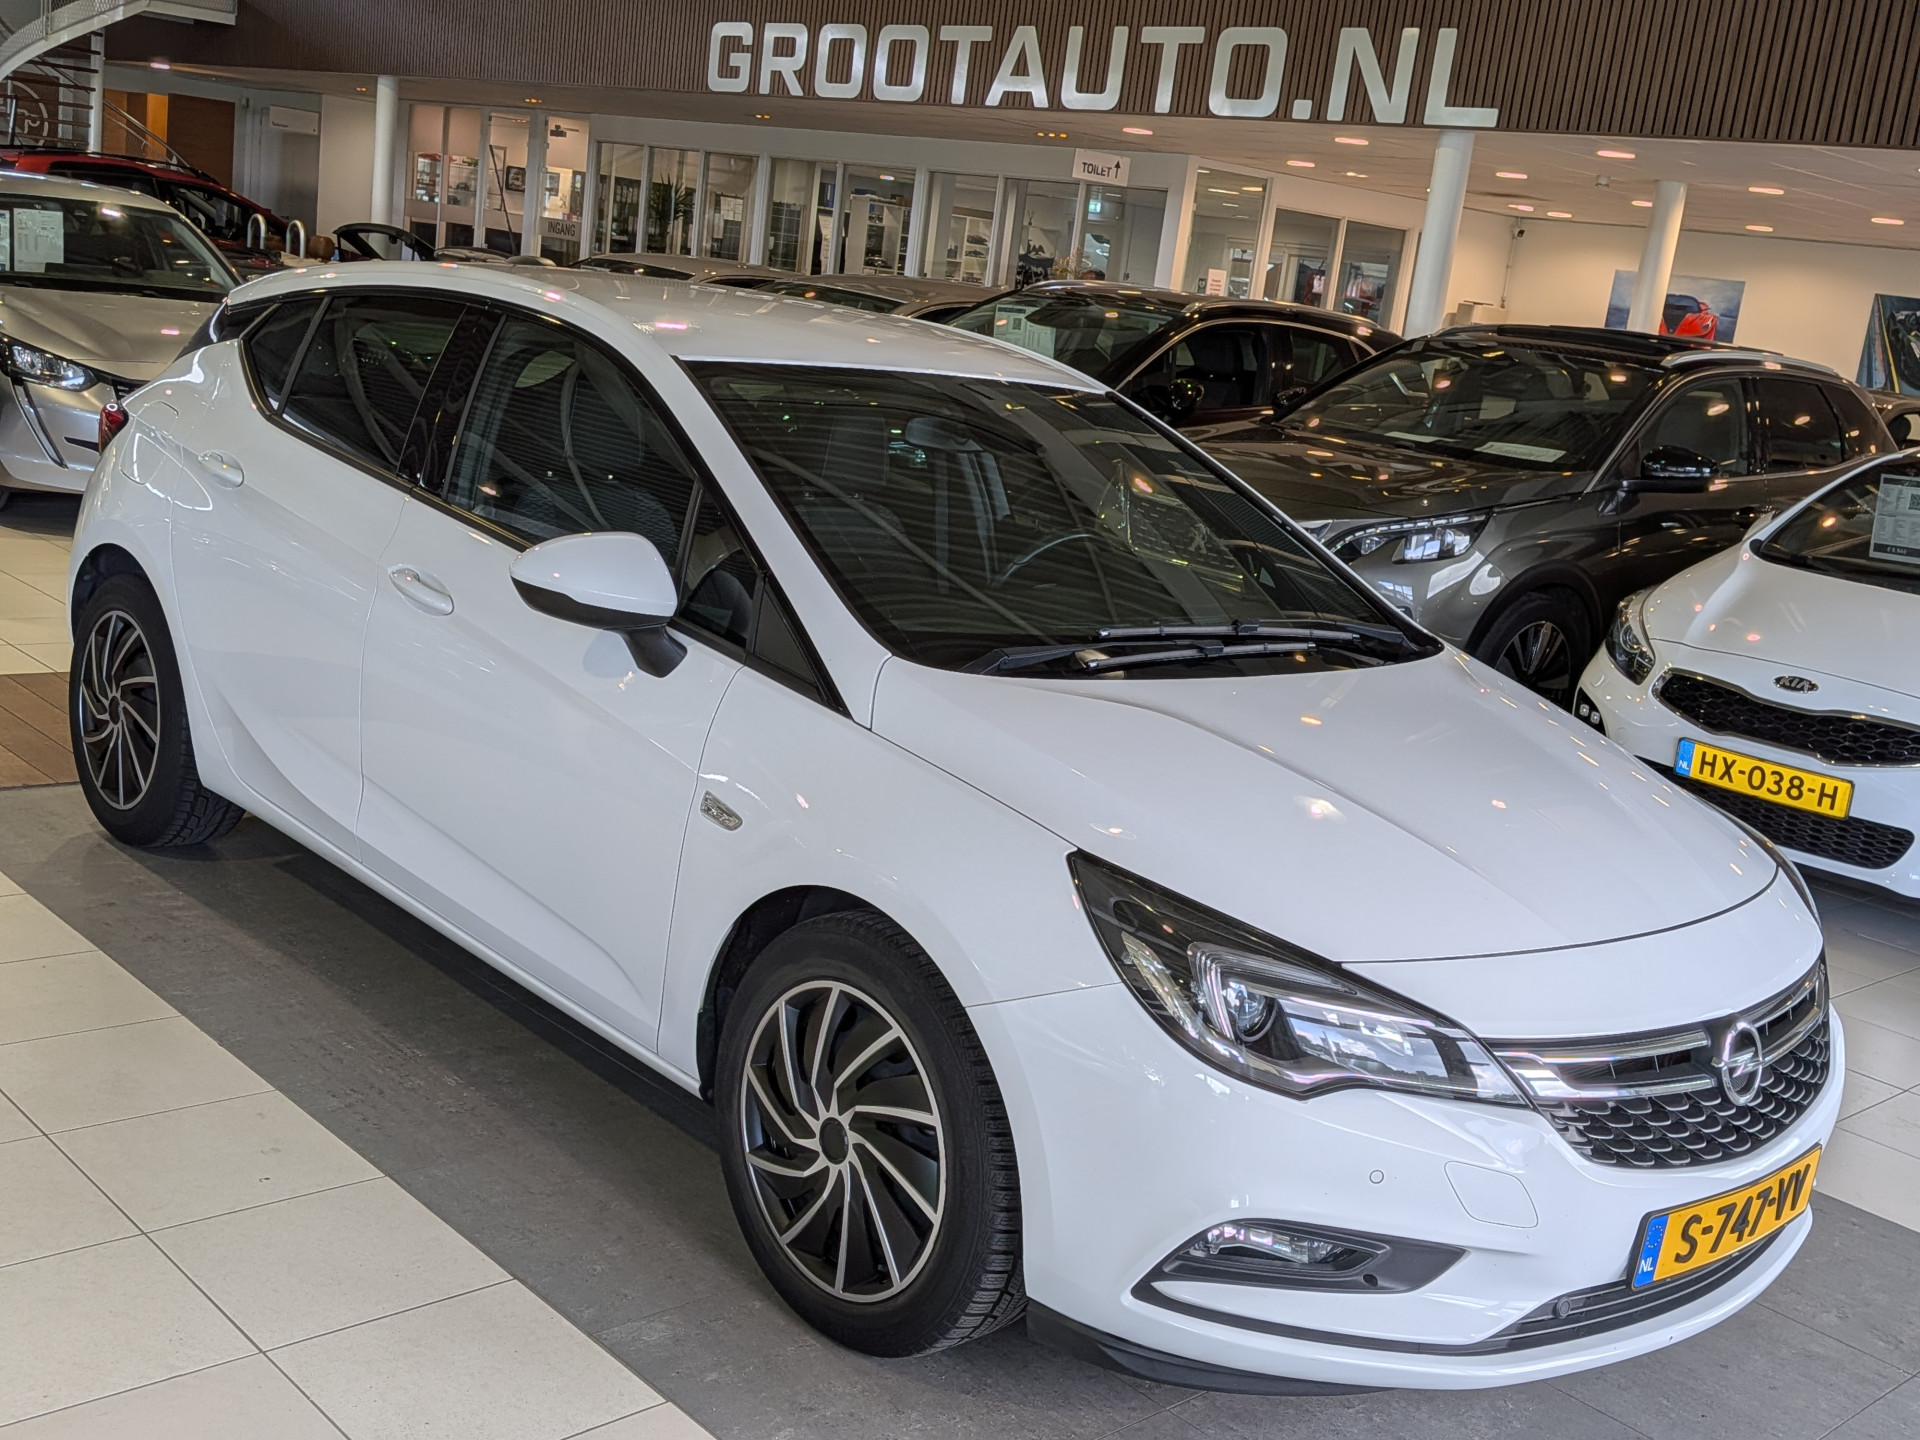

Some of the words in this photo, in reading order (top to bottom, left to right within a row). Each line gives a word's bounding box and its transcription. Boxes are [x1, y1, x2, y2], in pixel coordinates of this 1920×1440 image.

[707, 21, 1499, 128] GROOTAUTO.NL
[1082, 161, 1112, 178] TOILET
[548, 221, 576, 237] INGANG
[1780, 677, 1809, 693] KIA
[1678, 760, 1690, 770] NL
[1699, 751, 1839, 811] HX-038-H
[1639, 1257, 1654, 1274] NL
